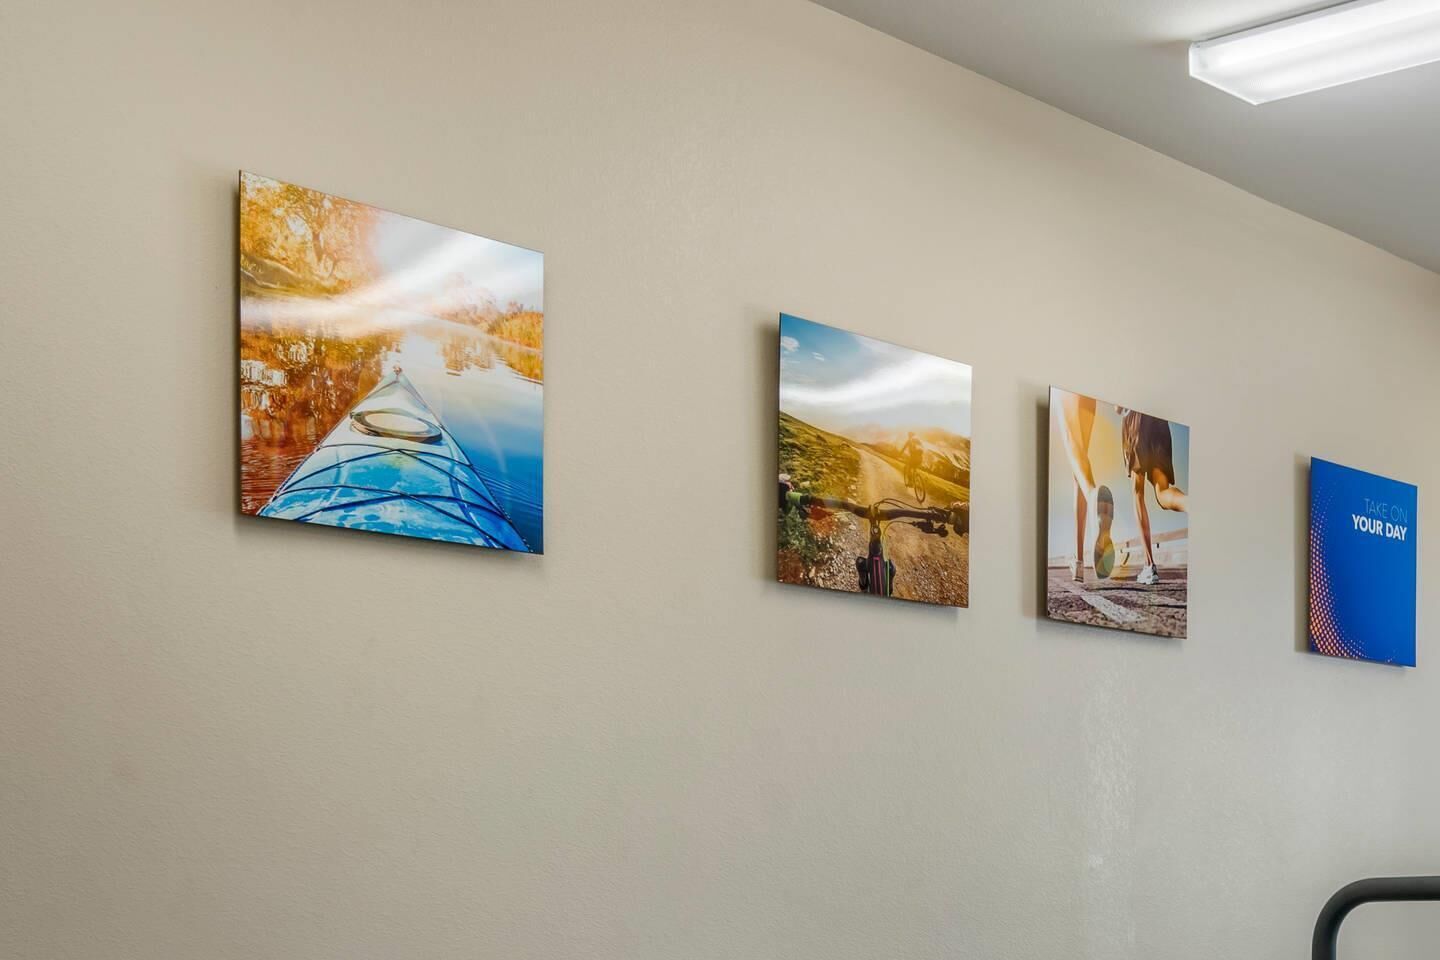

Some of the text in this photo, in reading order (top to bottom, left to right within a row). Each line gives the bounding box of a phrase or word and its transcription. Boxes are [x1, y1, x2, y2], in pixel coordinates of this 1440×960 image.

[1363, 498, 1408, 523] TAKE ON
[1351, 513, 1408, 541] YOUR DAY
